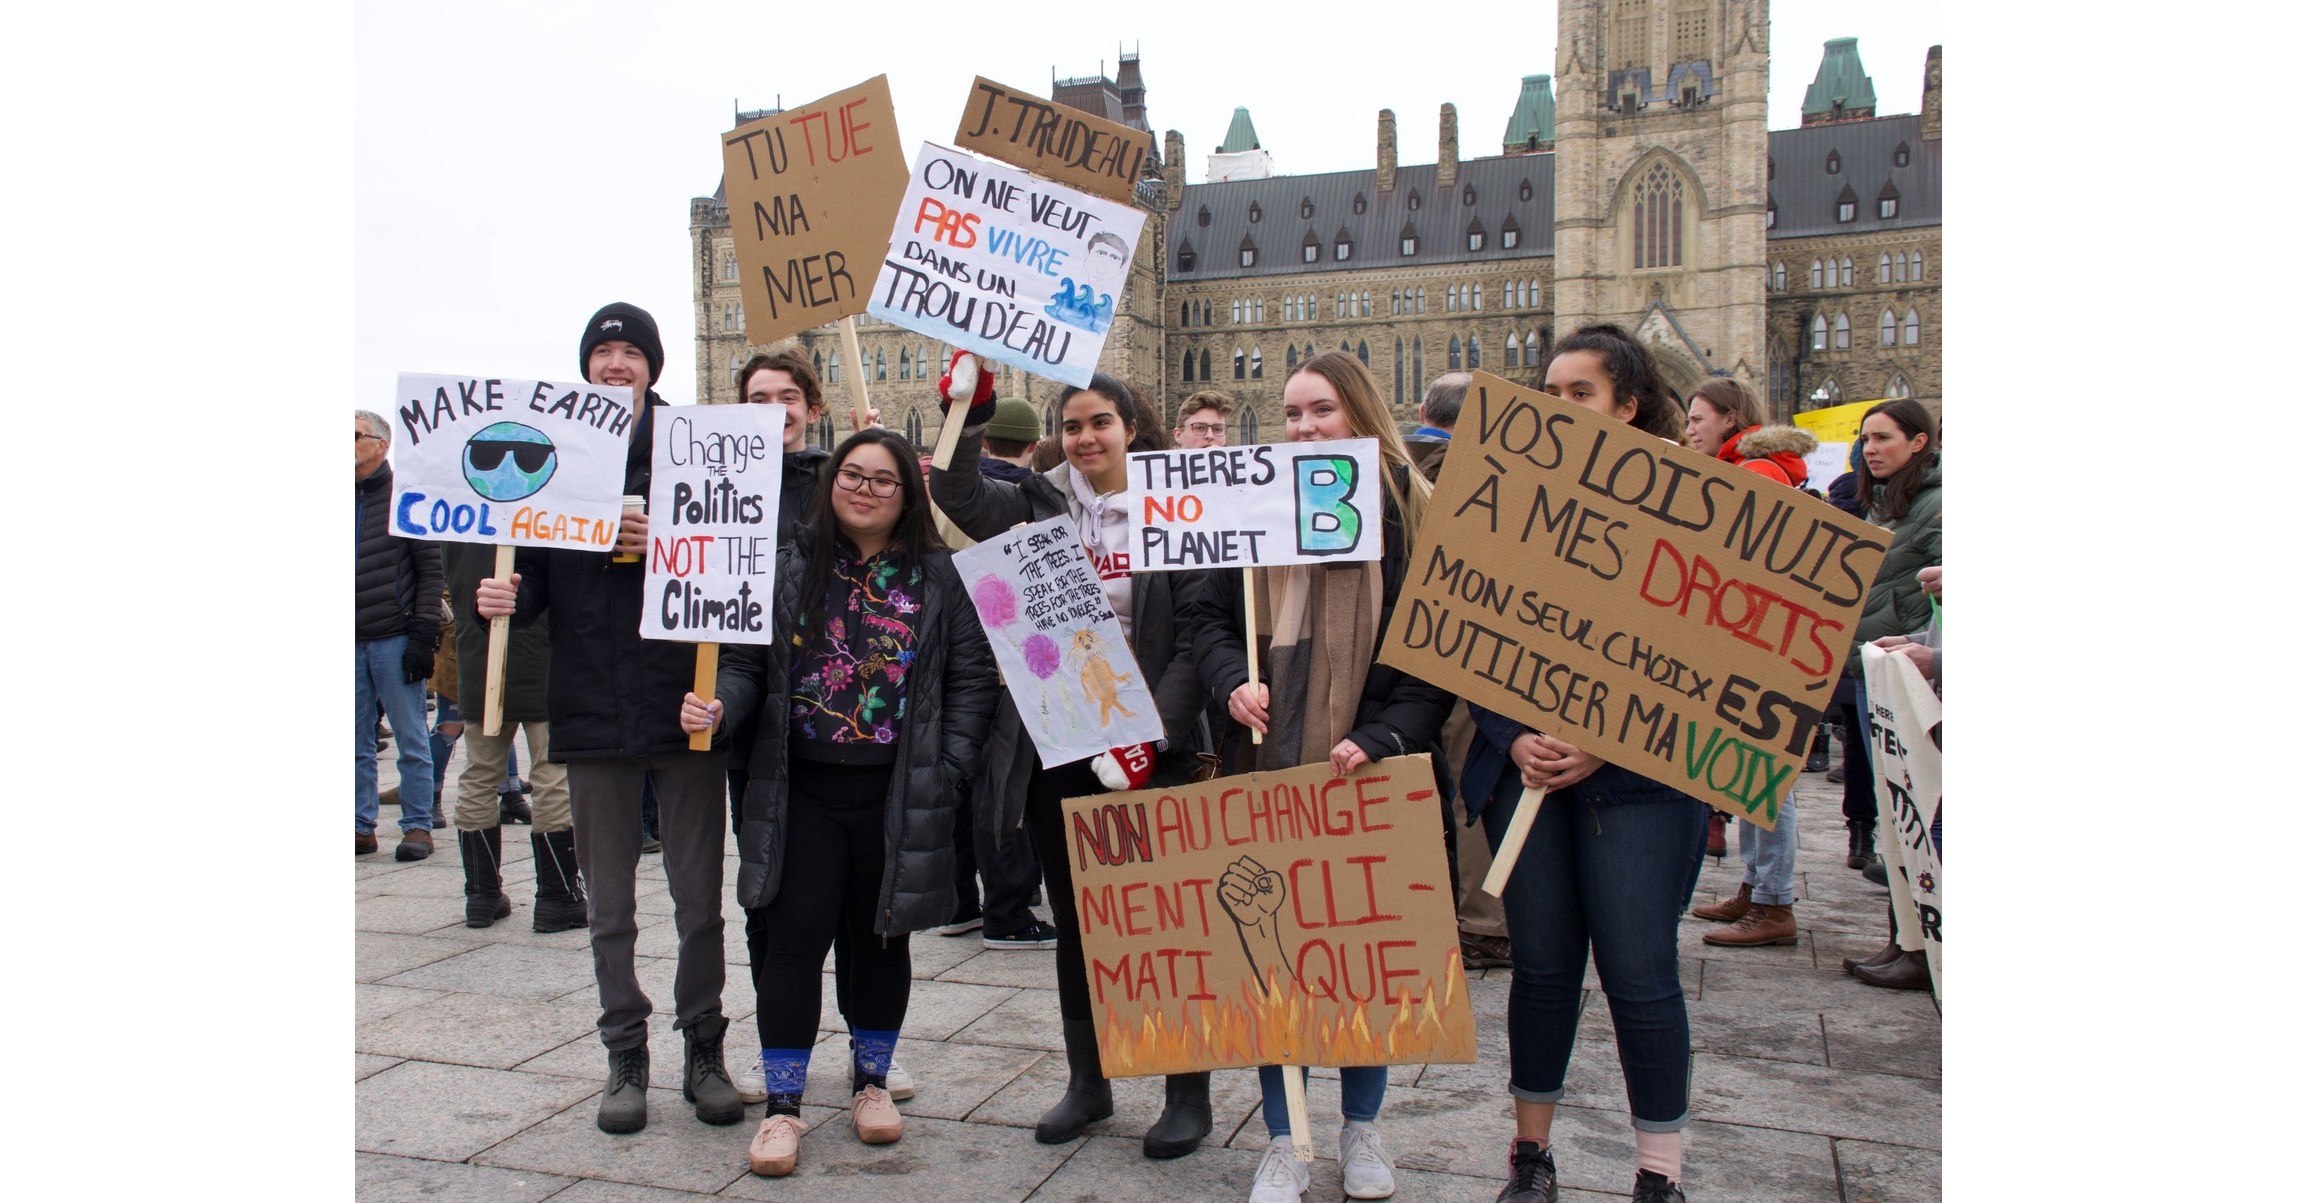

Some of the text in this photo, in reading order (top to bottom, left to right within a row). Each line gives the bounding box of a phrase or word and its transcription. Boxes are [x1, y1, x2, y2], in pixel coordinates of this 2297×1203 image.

[726, 97, 874, 181] TU TUE
[1007, 96, 1147, 185] TRUDEAU
[754, 194, 810, 241] MA
[924, 158, 1101, 239] ON NE VEUT
[913, 197, 1070, 278] PAS VIVRE
[762, 250, 855, 320] MER
[904, 241, 1016, 299] DANS UN
[885, 259, 1072, 366] TROU D'EAU
[400, 379, 632, 446] MAKE EARTH
[669, 417, 765, 474] Change
[707, 465, 728, 477] THE
[1478, 386, 1575, 470] VOS
[1578, 429, 1735, 533] LOIS
[397, 492, 614, 546] COOL AGAIN
[673, 478, 763, 526] Politics
[1132, 445, 1363, 555] THERE'S B
[1144, 494, 1204, 527] NO
[1453, 454, 1508, 533] À
[1520, 484, 1629, 582] MES
[653, 536, 768, 578] NOT THE
[1019, 558, 1046, 583] THE
[1070, 544, 1085, 561] I
[1028, 533, 1054, 554] SPEAK
[1050, 525, 1069, 543] FOR
[1142, 527, 1267, 567] PLANET
[662, 580, 763, 633] Climate
[1023, 567, 1088, 603] SPEAK FOR THE
[1025, 601, 1051, 622] TREES
[1050, 594, 1067, 611] FOR
[1065, 589, 1081, 604] THE
[1035, 618, 1056, 632] HAVE
[1055, 612, 1069, 624] NO
[1421, 544, 1826, 758] MON SEUL CHOIX EST
[1402, 598, 1793, 823] D'UTILISER MA VOIX
[1072, 803, 1153, 871] NON
[1156, 794, 1211, 857] AU
[1081, 878, 1214, 938] MENT
[1092, 938, 1423, 1006] MATI QUE
